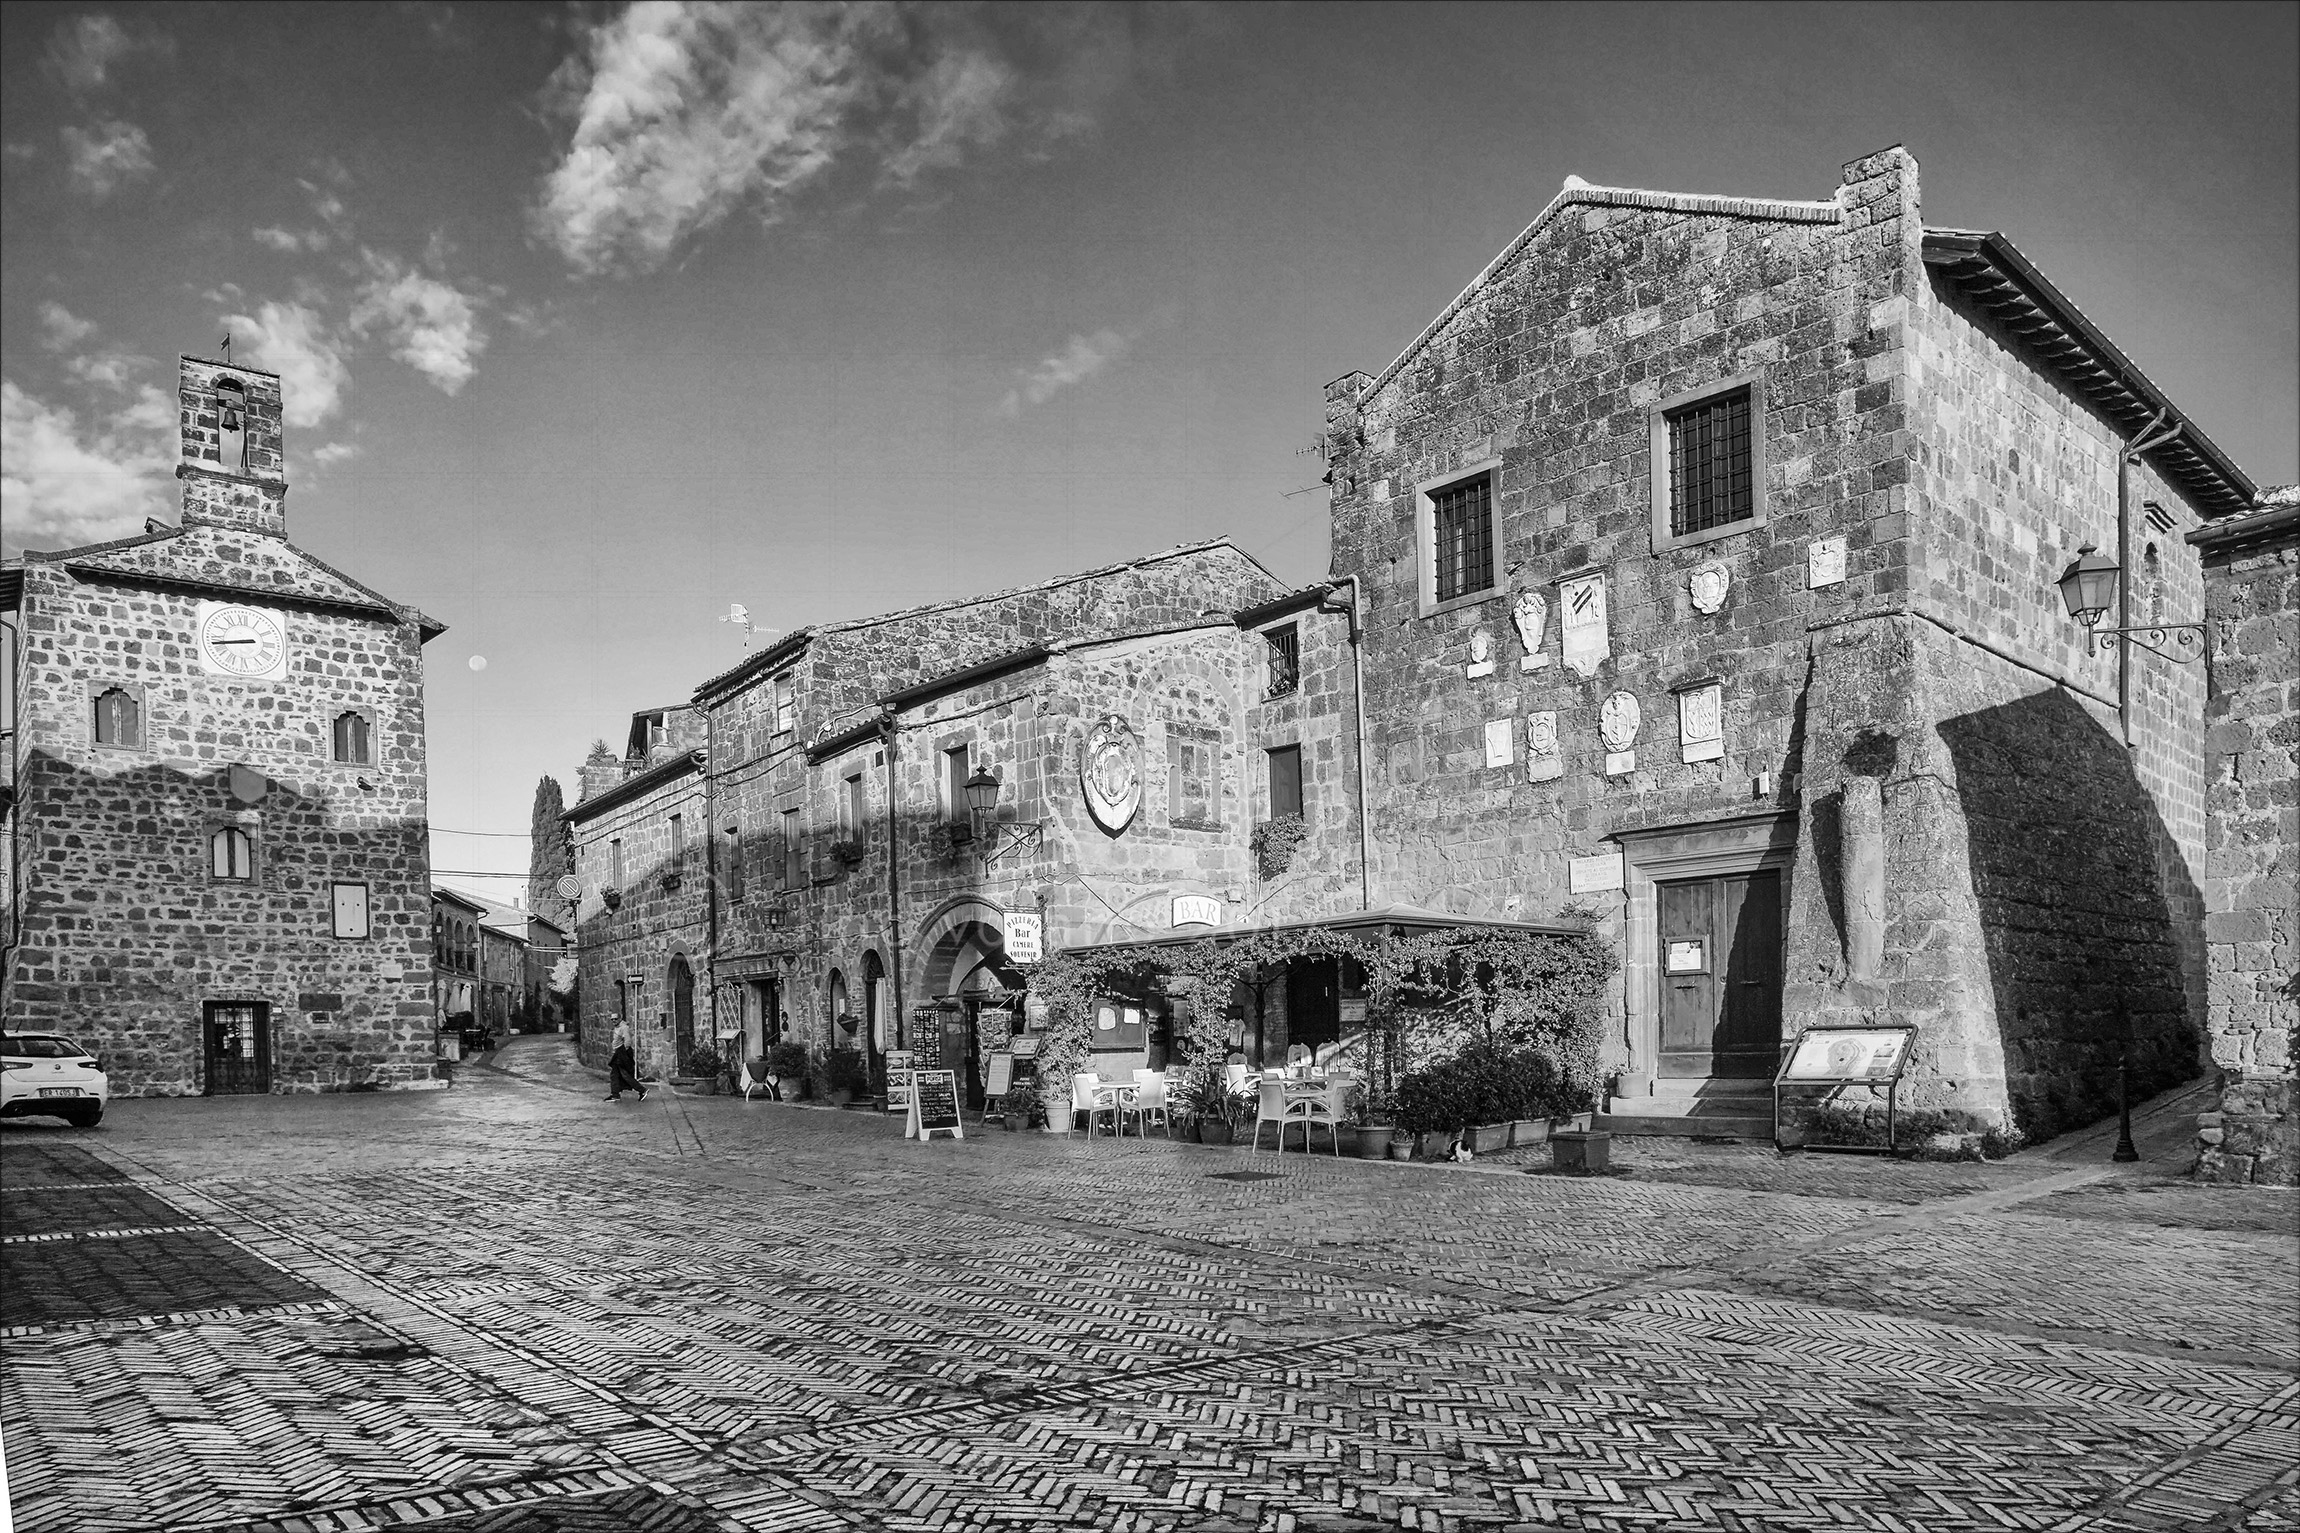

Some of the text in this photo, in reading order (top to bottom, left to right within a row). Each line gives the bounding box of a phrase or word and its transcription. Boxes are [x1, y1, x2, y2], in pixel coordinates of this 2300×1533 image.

[1180, 900, 1216, 923] BAR
[1006, 916, 1039, 930] PIZZERIA
[1015, 928, 1031, 938] Bar
[1012, 941, 1034, 949] CAMERE
